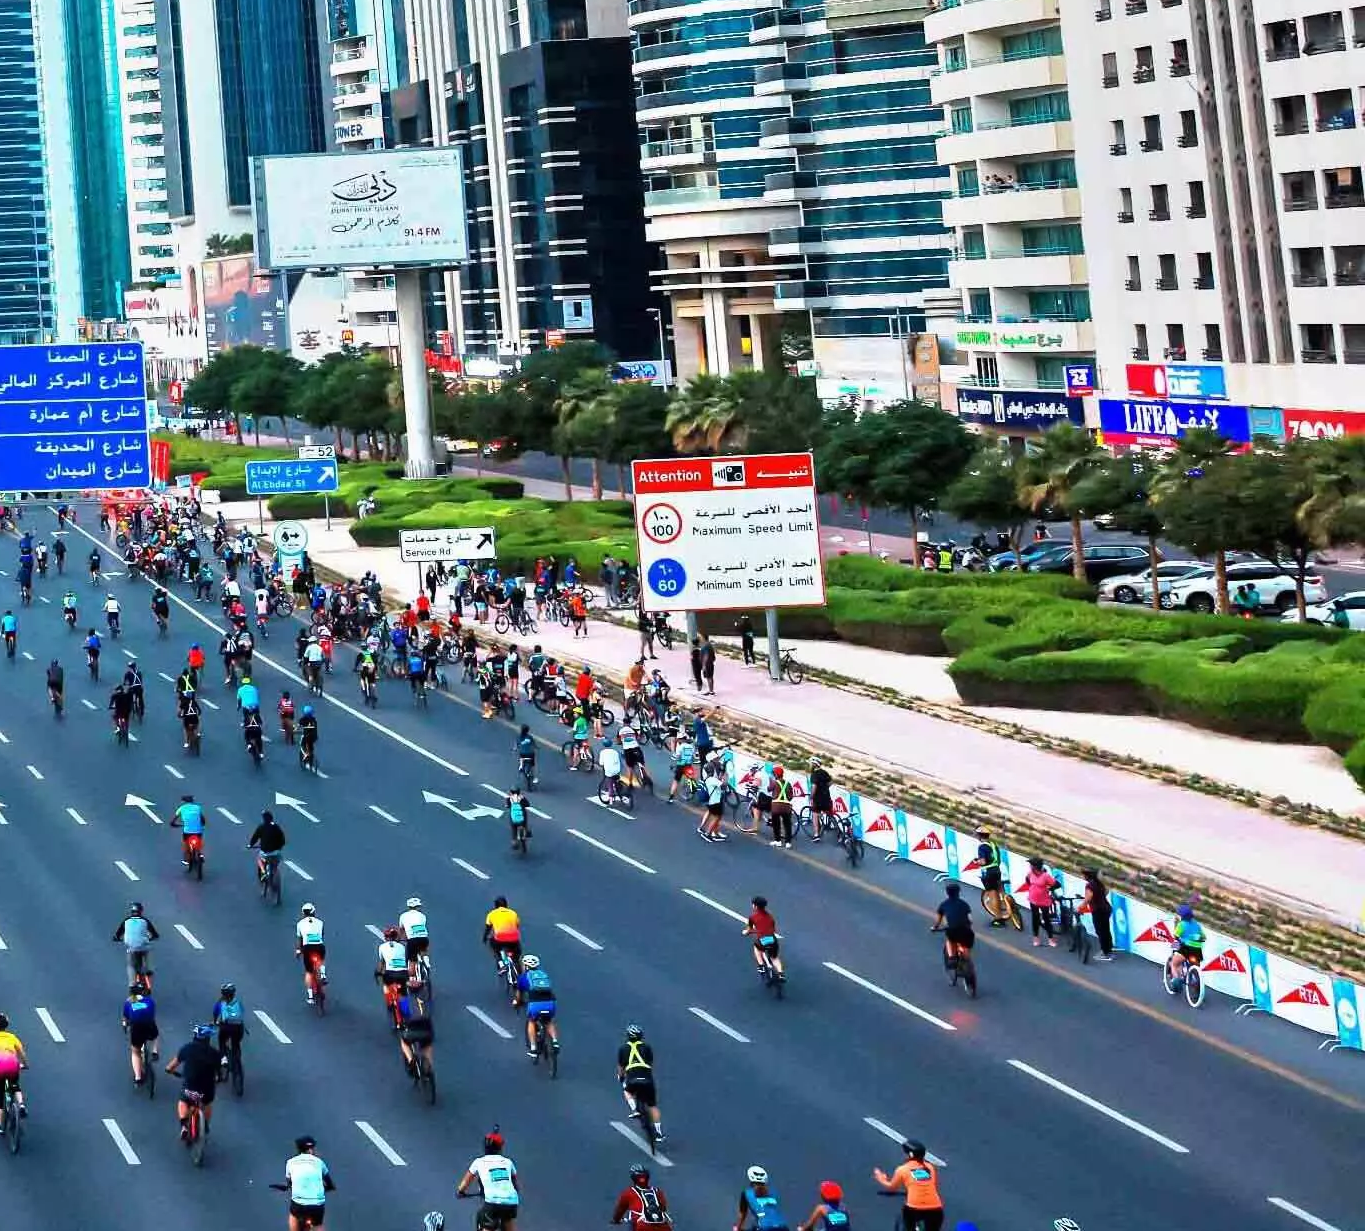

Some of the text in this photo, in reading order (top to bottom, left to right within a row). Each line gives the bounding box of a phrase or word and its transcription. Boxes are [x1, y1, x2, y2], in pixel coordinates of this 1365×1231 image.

[404, 227, 441, 237] 91.4 FM
[47, 348, 137, 366] شارع الصفا
[46, 372, 91, 389] المركز
[99, 372, 138, 389] شارع
[29, 402, 140, 425] شارع أم عمارة
[1123, 403, 1166, 434] LIFE
[34, 437, 142, 456] شارع الحديقة
[318, 446, 333, 457] 52
[45, 461, 143, 480] شارع الميدان
[286, 463, 311, 476] شارع
[639, 468, 702, 483] Attention
[695, 504, 812, 520] الحد الأقصى للسرعة
[651, 524, 674, 537] 100
[692, 522, 814, 536] Maximum Speed Limit
[404, 532, 472, 544] شارع خدمات
[405, 549, 437, 557] Service
[707, 557, 817, 574] الحد الأدنى للسرعة
[658, 580, 677, 593] 60
[697, 575, 814, 591] Minimum Speed Limit
[924, 836, 939, 850] RTA
[1219, 955, 1238, 971] RTA
[1298, 987, 1319, 1004] RTA
